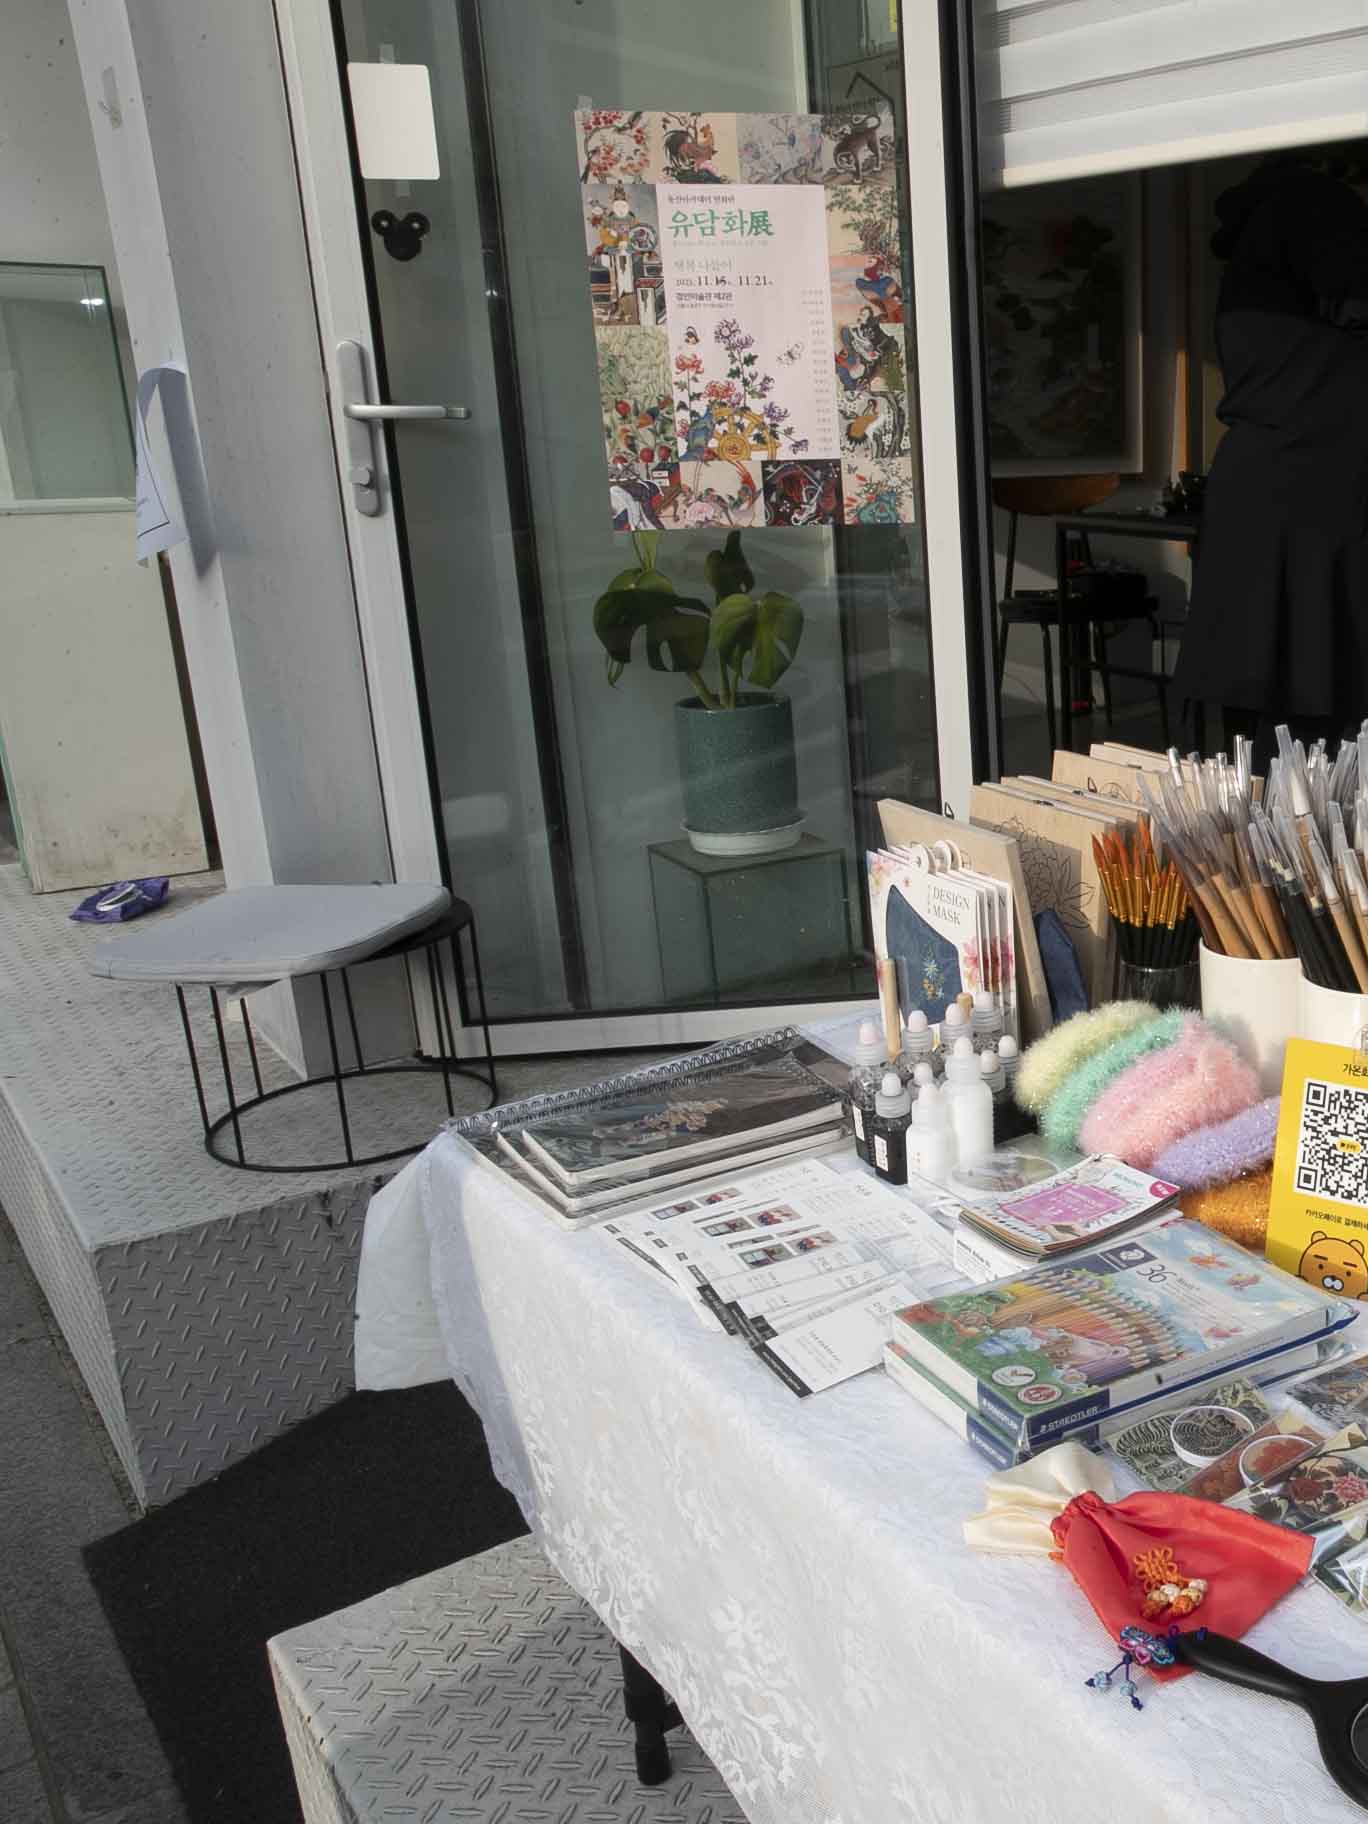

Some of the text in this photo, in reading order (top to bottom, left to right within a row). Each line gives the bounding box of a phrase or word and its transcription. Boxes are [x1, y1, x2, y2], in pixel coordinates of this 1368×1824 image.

[933, 886, 970, 911] DESIGN
[933, 903, 961, 928] MASK
[1136, 1264, 1178, 1284] 36
